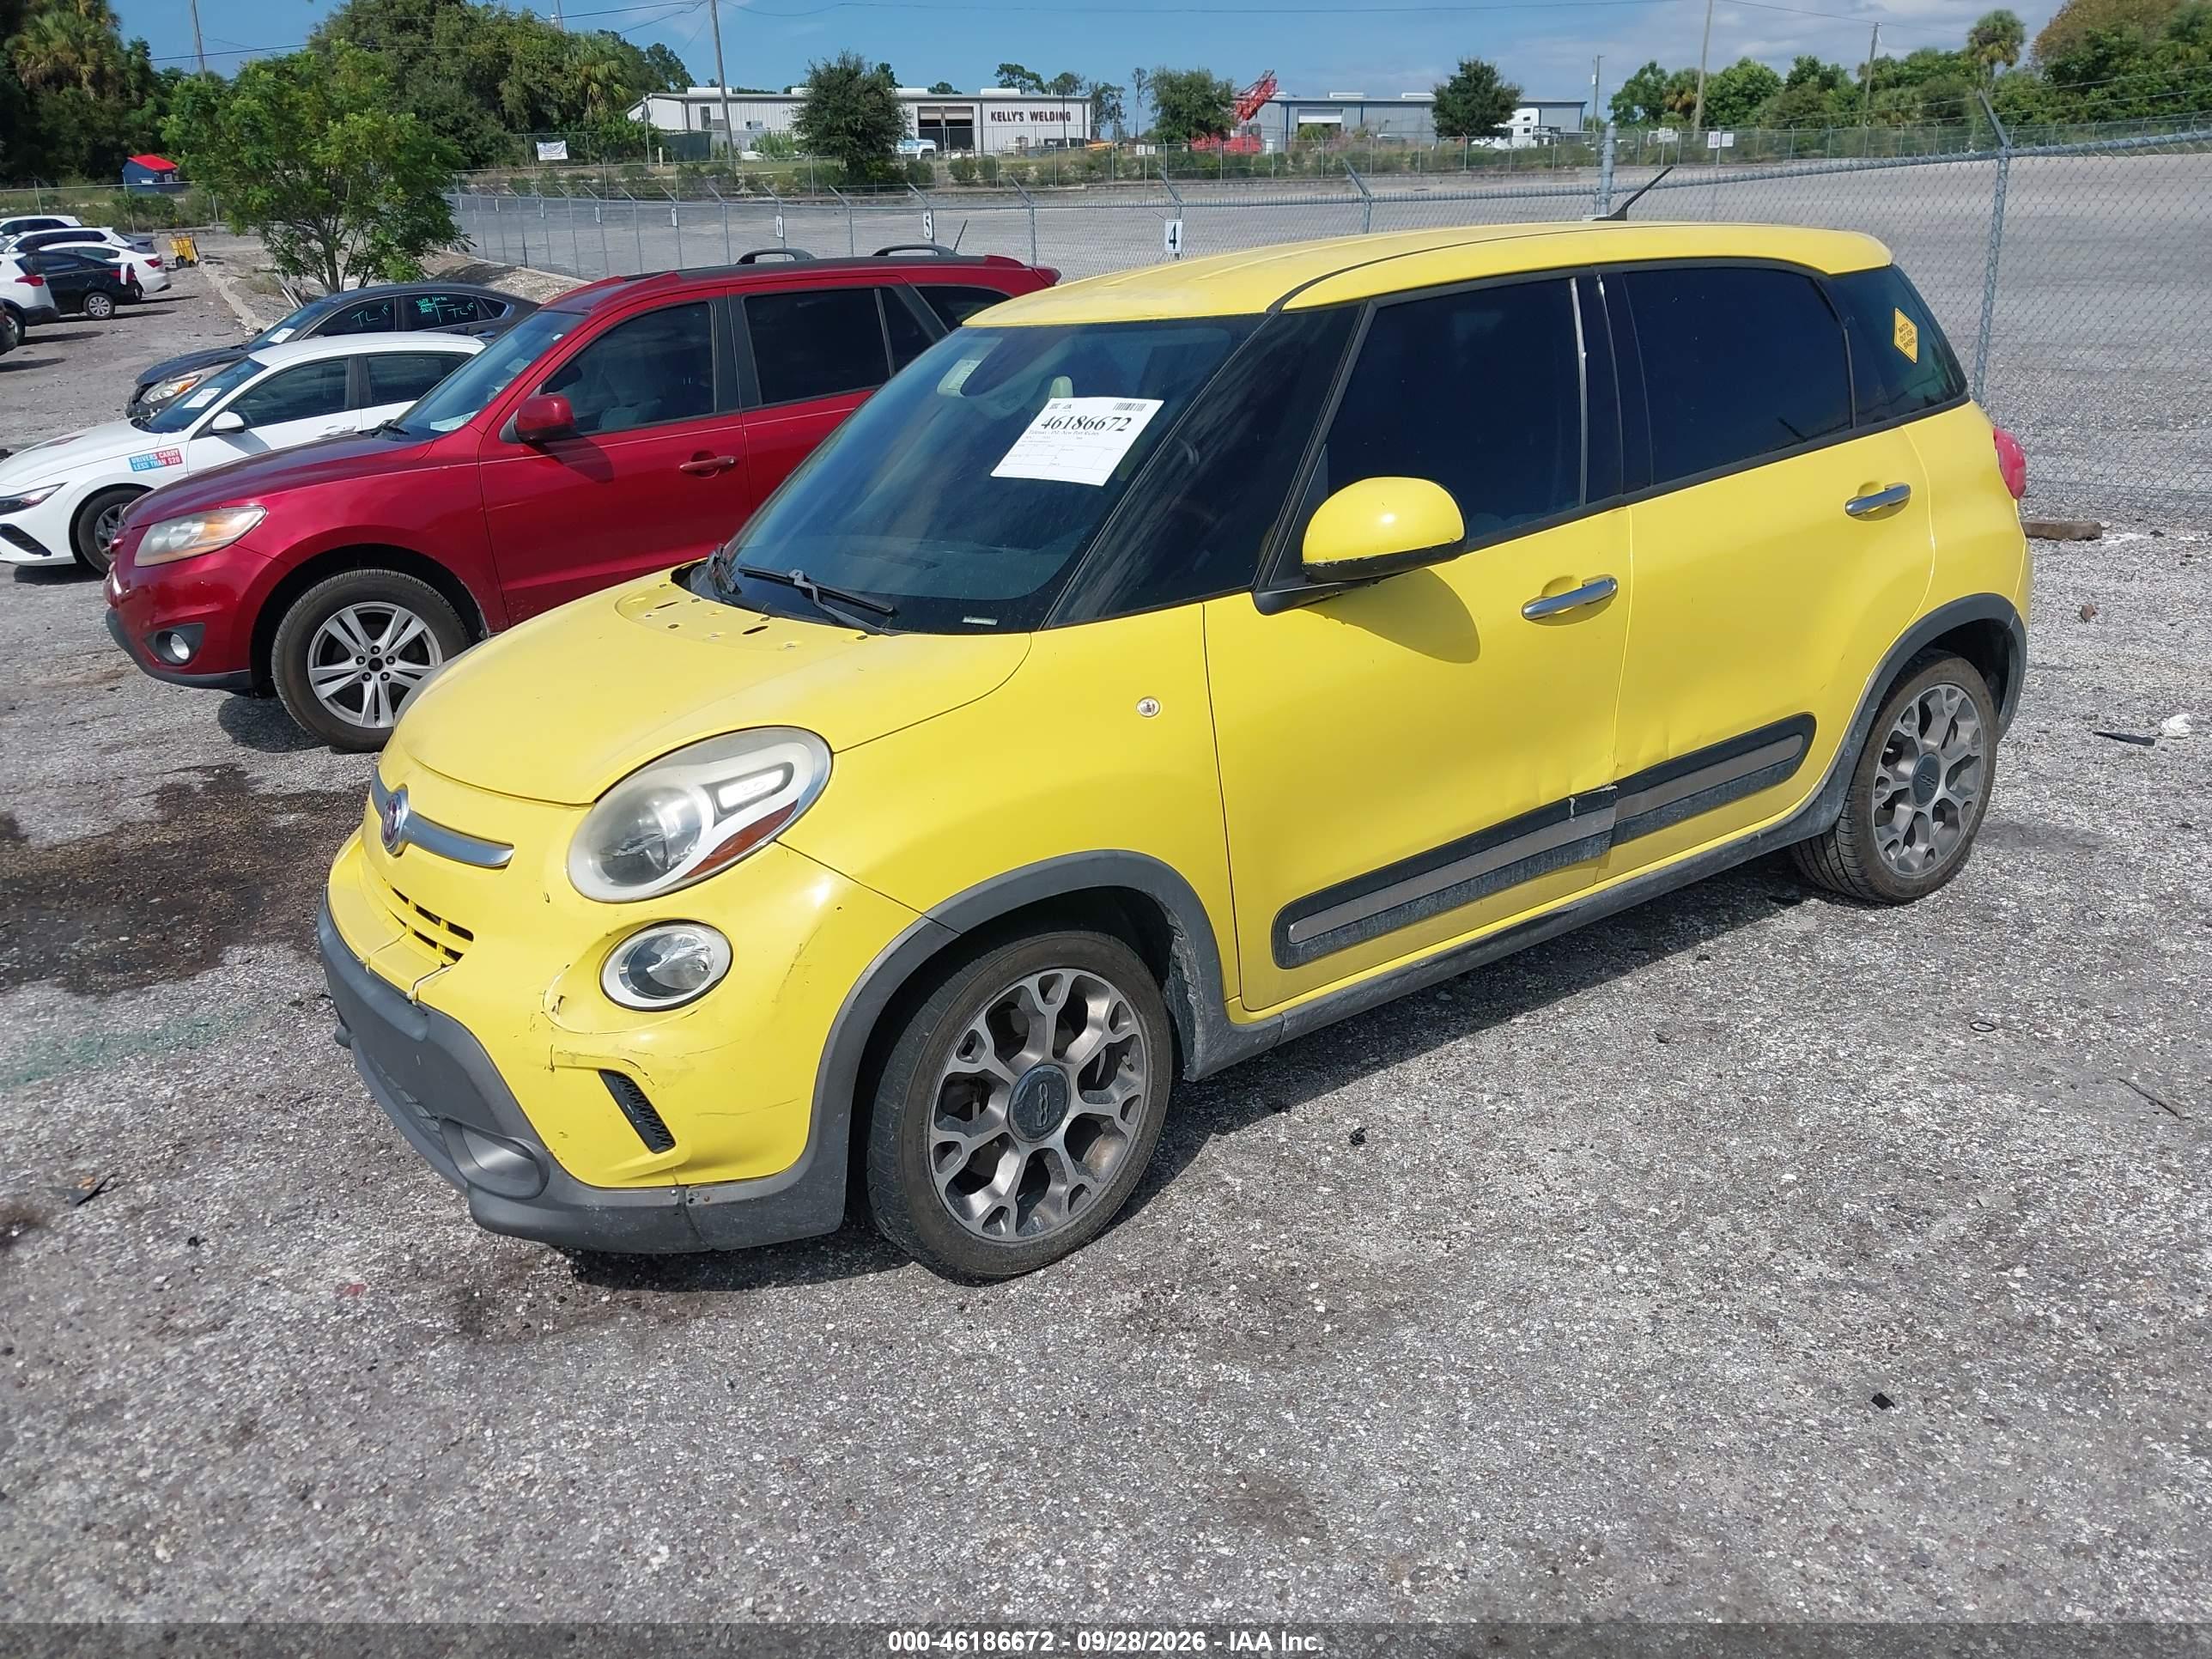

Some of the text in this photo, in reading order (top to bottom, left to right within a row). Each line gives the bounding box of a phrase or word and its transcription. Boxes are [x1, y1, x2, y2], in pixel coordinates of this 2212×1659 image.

[990, 111, 1072, 122] KELLY'S WELDING
[777, 218, 782, 235] 6
[925, 215, 931, 236] 5
[1168, 222, 1177, 250] 4
[351, 310, 378, 328] TL
[1041, 415, 1133, 432] 46186672
[131, 450, 179, 464] DRIVERS CARRY
[149, 459, 167, 468] THAN
